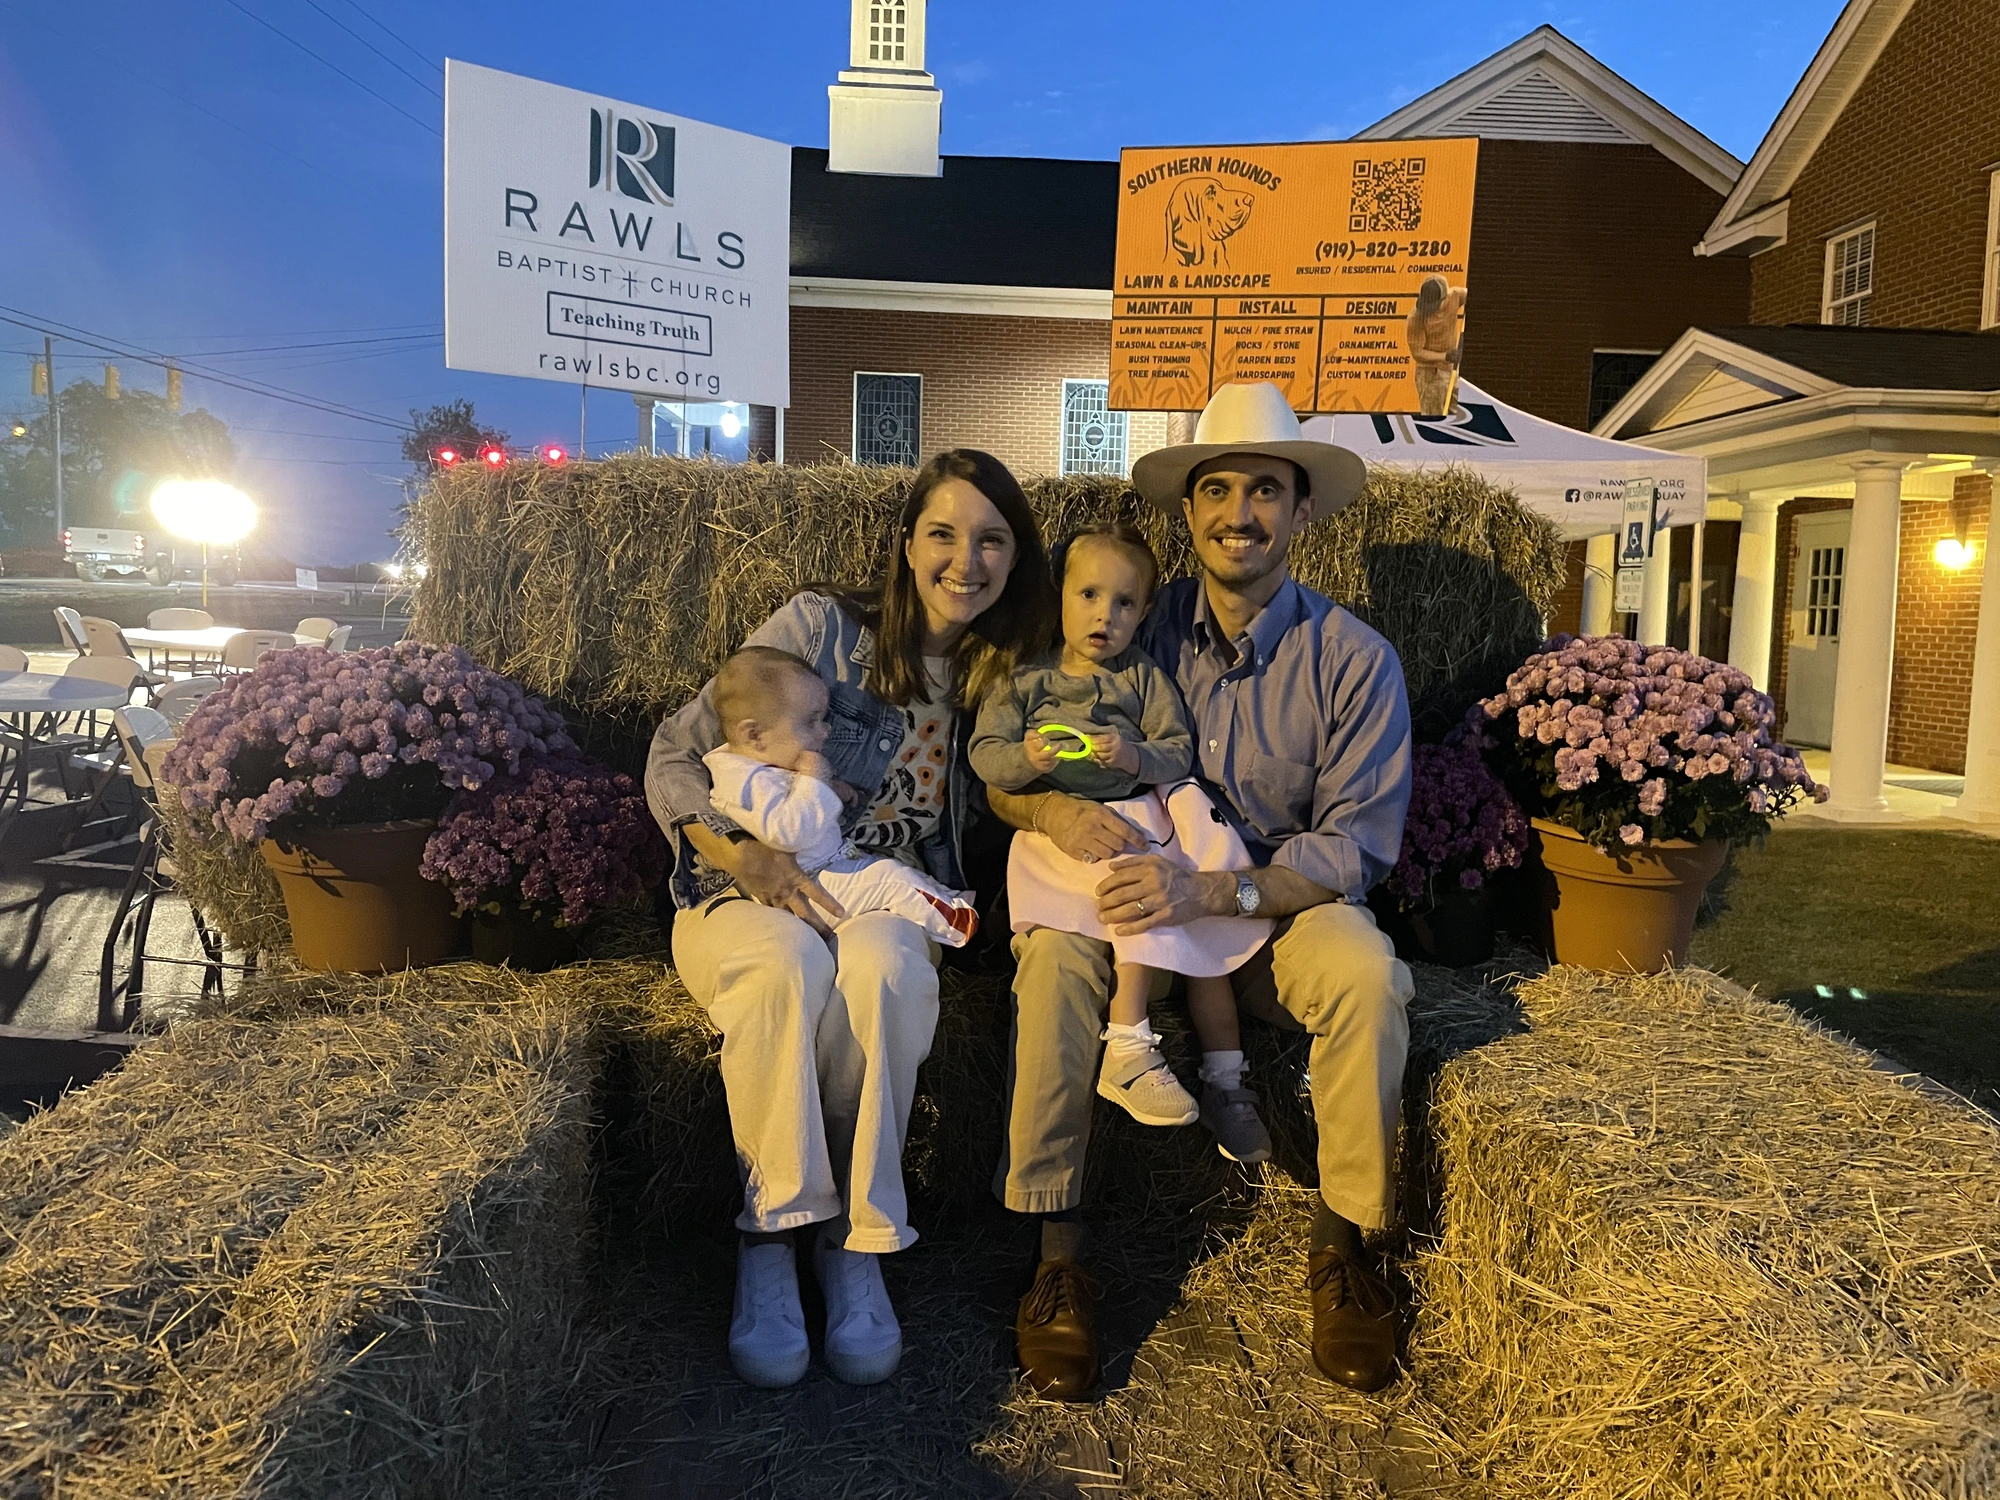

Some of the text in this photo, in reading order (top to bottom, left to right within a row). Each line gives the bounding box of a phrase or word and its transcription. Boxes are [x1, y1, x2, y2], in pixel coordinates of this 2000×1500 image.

[1127, 156, 1282, 196] SOUTHERN HOUNDS
[504, 187, 745, 270] RAWLS
[1315, 240, 1451, 262] (919)-820-3280
[1296, 265, 1331, 275] INSURED
[1341, 265, 1396, 274] RESIDENTIAL
[1407, 263, 1464, 273] COMMERCIAL
[498, 250, 752, 308] BAPTIST CHURCH
[1124, 273, 1271, 289] LAWN & LANDSCAPE
[1126, 301, 1193, 315] MAINTAIN
[1238, 300, 1297, 314] INSTALL
[1345, 300, 1397, 315] DESIGN
[561, 307, 701, 342] Teaching Truth
[1119, 326, 1204, 335] LAWN MAINTENANCE
[1224, 326, 1252, 335] MULCH
[1262, 326, 1281, 335] PINE
[1284, 326, 1314, 335] STRAW
[1353, 325, 1386, 335] NATIVE
[1115, 341, 1207, 349] SEASONAL CLEAN-UPS
[1235, 341, 1262, 349] ROCKS
[1273, 341, 1300, 349] STONE
[1339, 340, 1398, 349] ORNAMENTAL
[1128, 355, 1191, 364] BUSH TRIMMING
[1237, 356, 1296, 364] GARDEN BEDS
[1325, 355, 1410, 364] LOW-MAINTENANCE
[539, 352, 721, 395] rawlsbc.org
[1128, 370, 1190, 378] TREE REMOVAL
[1236, 370, 1295, 379] HARDSCAPING
[1326, 370, 1407, 379] CUSTOM TAILORED
[1599, 479, 1685, 489] RAW.ORG
[1583, 490, 1686, 501] @RAWUAY
